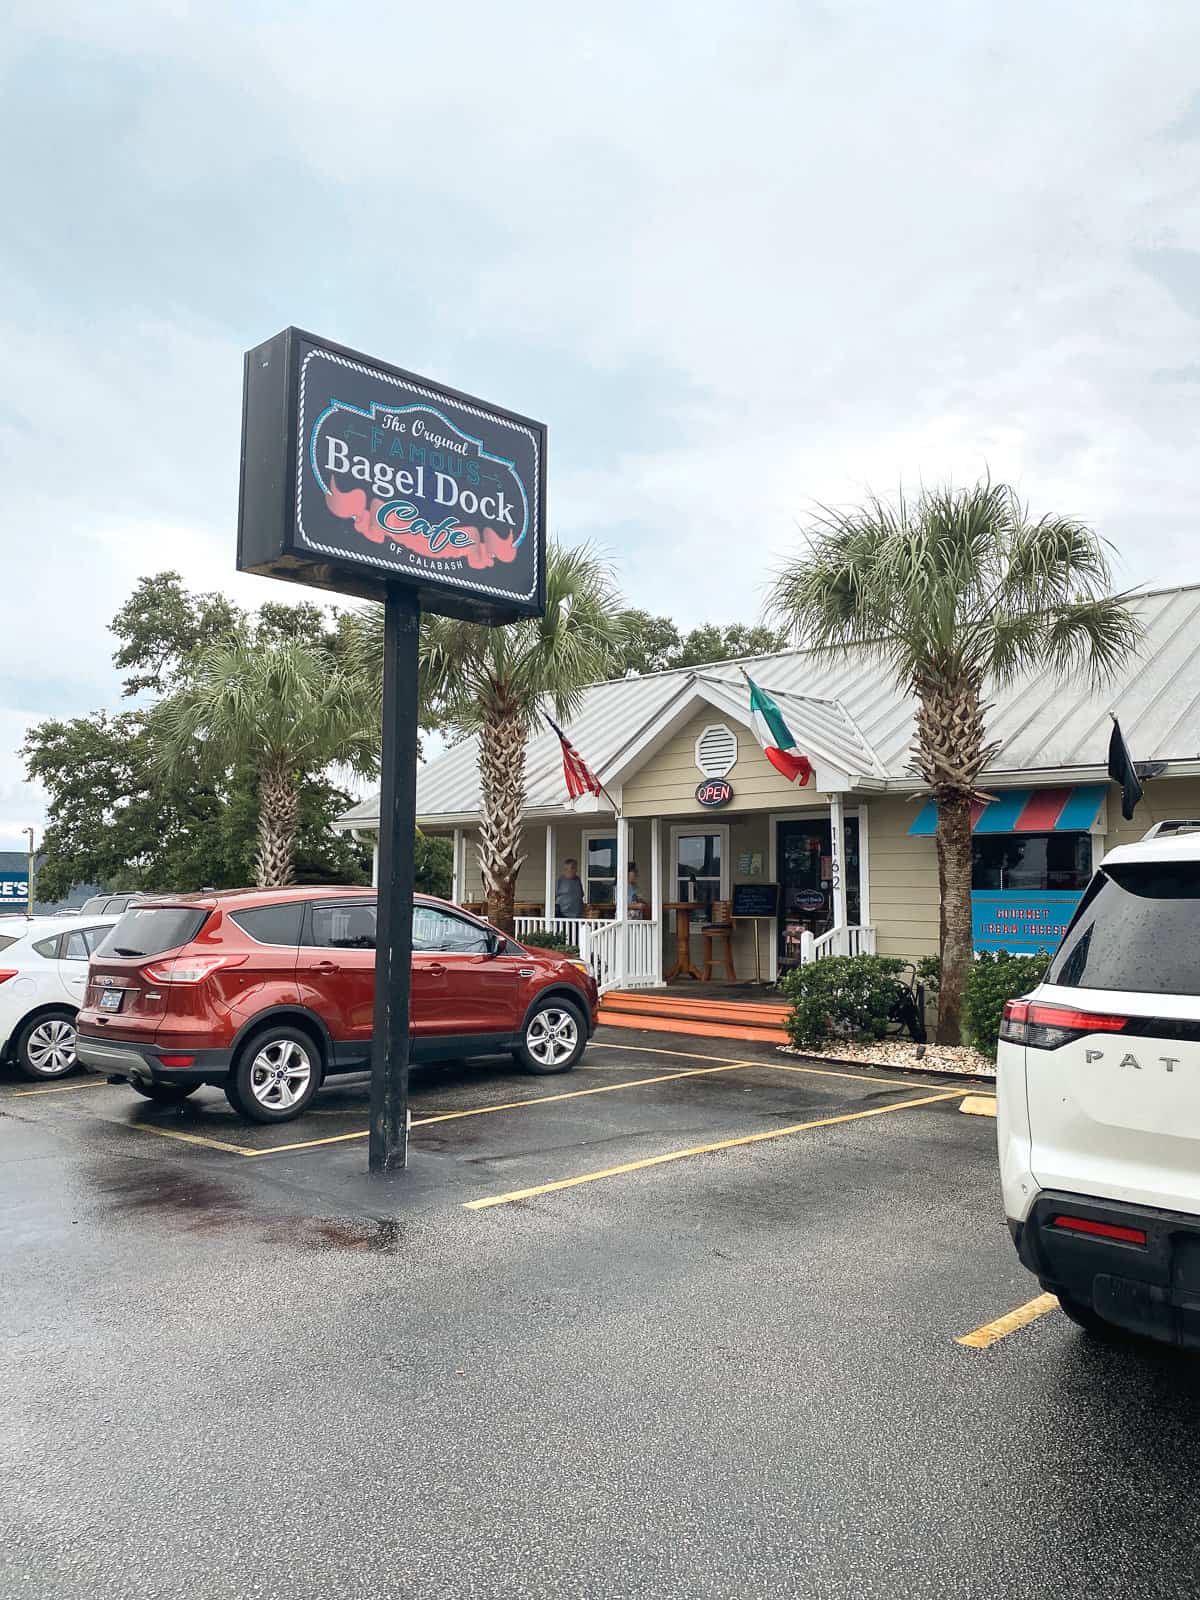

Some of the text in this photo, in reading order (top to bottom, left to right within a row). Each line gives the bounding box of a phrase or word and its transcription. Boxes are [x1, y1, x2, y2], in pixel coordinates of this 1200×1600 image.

[382, 414, 470, 456] The Original
[370, 428, 481, 485] FAMOUS
[324, 435, 516, 526] Bagel Dock
[375, 500, 475, 553] Cafe
[390, 543, 464, 569] OF CALABASH
[698, 786, 730, 800] OPEN
[831, 826, 840, 889] 1162
[0, 881, 28, 896] E'S
[981, 923, 1018, 934] CREAM
[997, 909, 1050, 920] GOURMET
